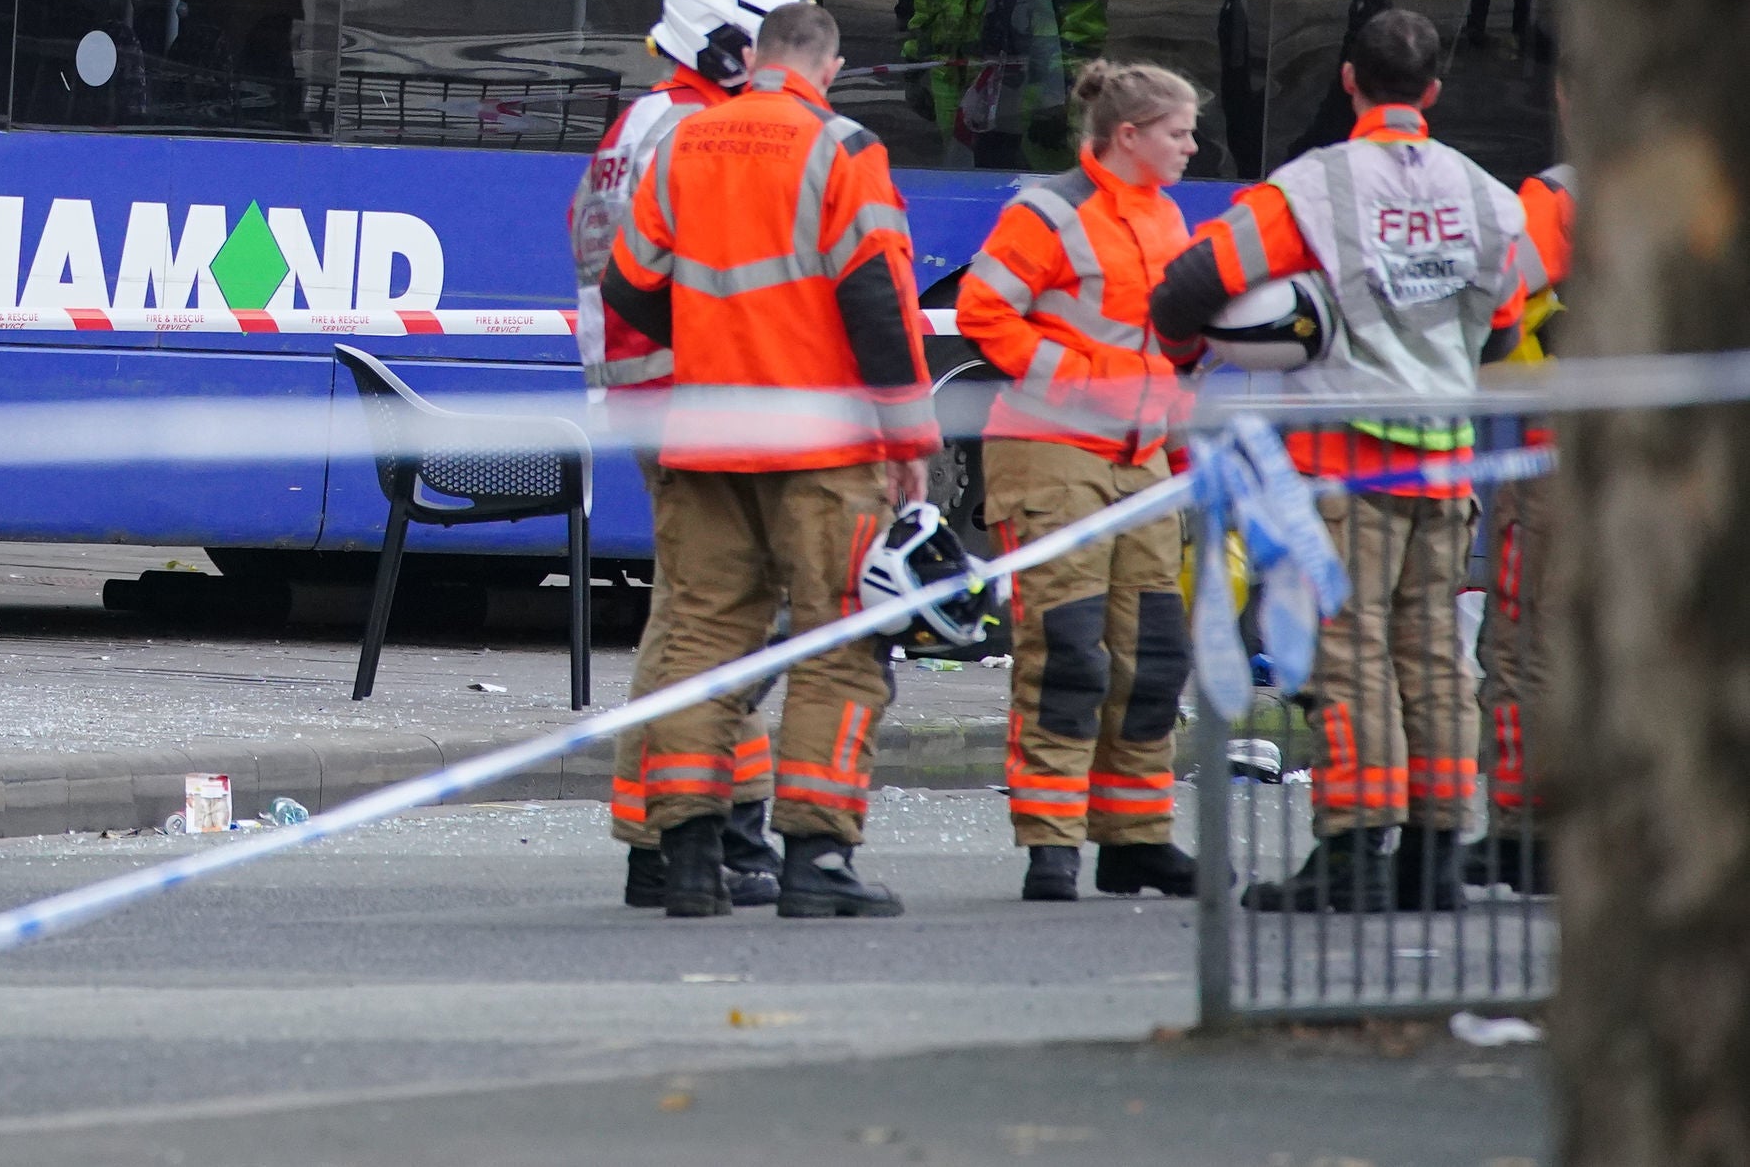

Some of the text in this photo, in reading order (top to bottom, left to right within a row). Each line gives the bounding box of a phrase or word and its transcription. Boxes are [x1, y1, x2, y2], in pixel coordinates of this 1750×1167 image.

[8, 313, 39, 321] RESCUE
[146, 314, 205, 323] FIRE & RESCUE
[311, 315, 370, 324] FIRE & RESCUE
[475, 316, 534, 325] FIRE & RESCUE
